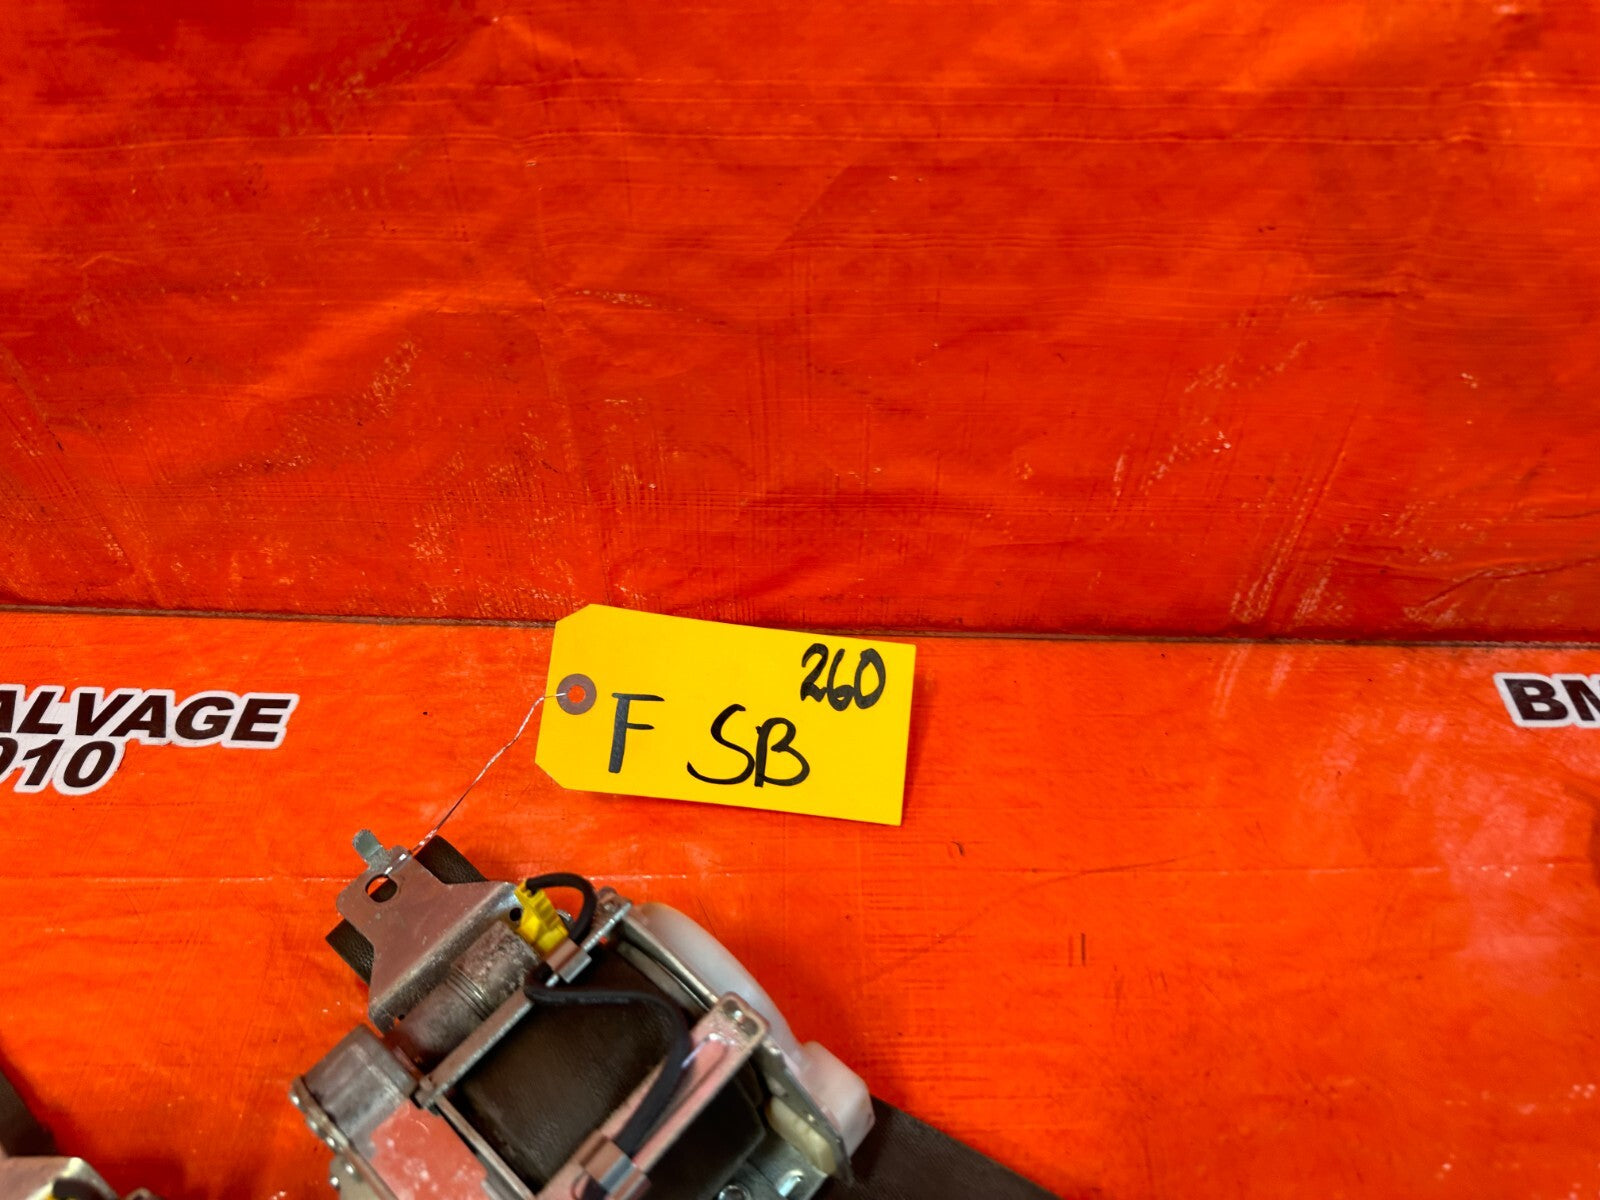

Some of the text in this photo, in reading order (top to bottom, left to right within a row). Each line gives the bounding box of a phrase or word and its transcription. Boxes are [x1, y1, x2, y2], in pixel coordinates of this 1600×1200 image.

[800, 643, 886, 711] 260
[608, 692, 811, 787] F SB
